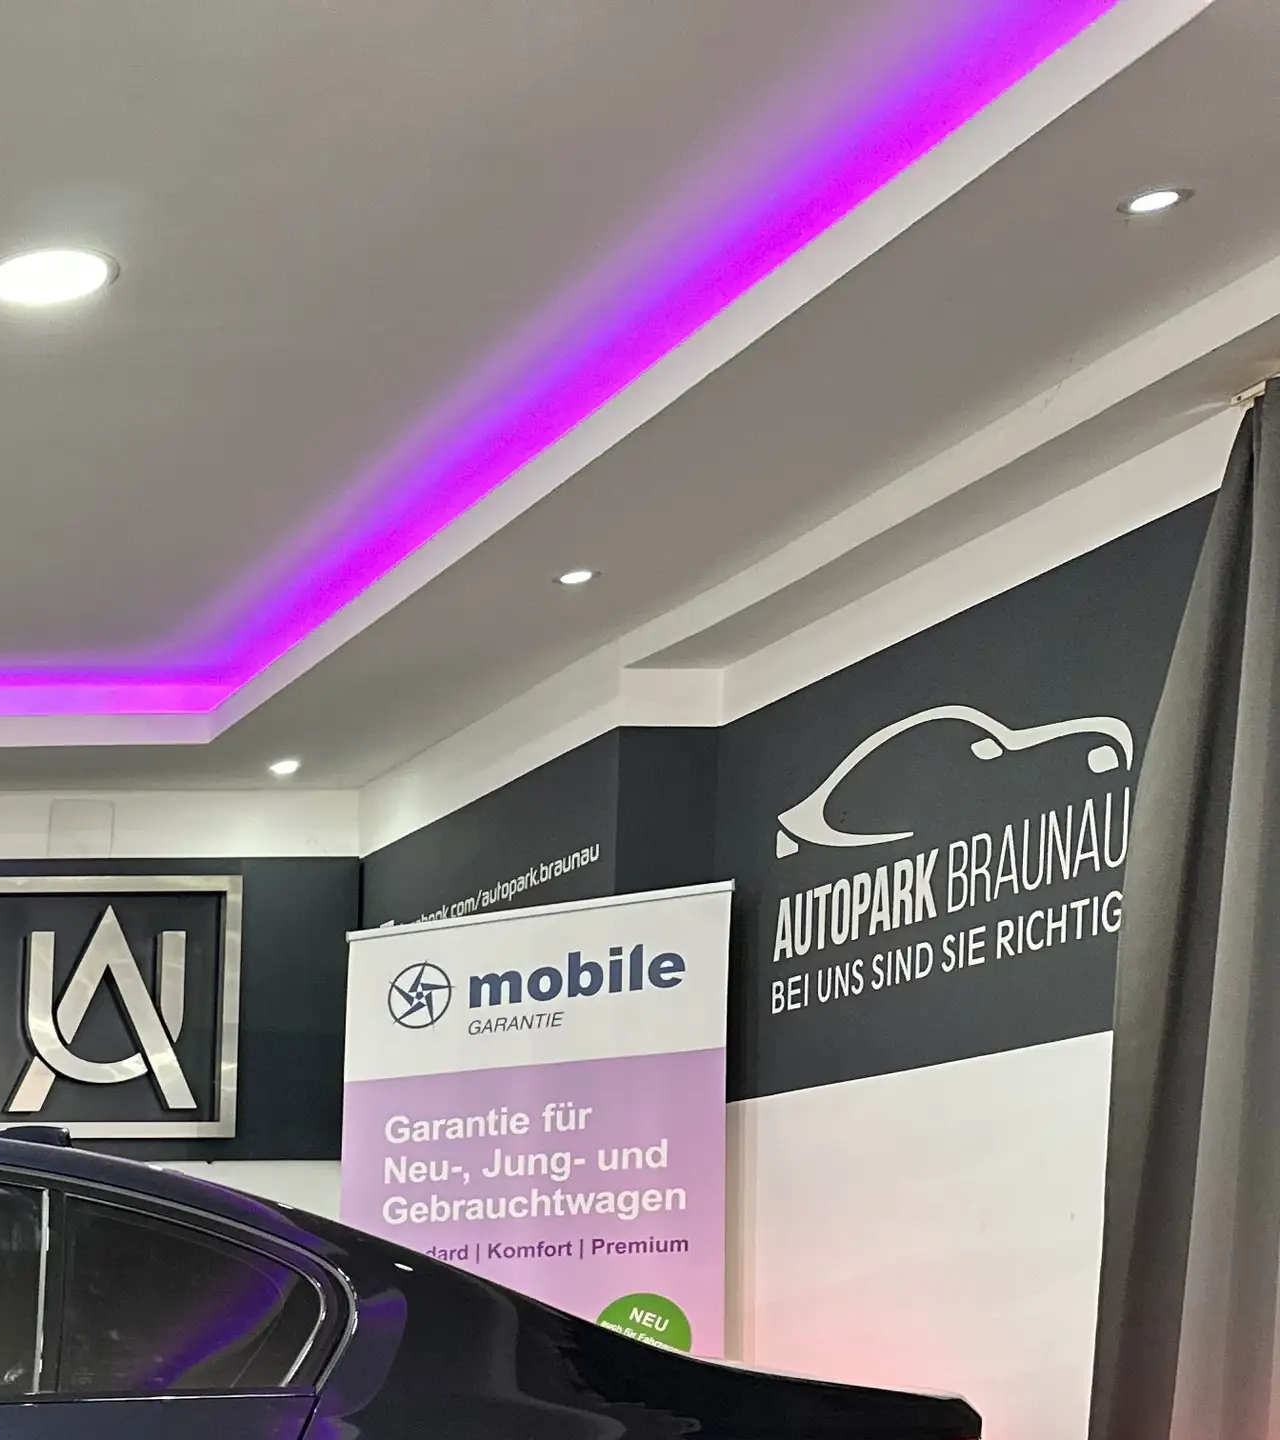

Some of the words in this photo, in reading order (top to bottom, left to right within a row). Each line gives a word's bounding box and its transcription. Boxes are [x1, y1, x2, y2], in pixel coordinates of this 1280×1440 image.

[773, 847, 941, 963] AUTOPARK
[947, 787, 1131, 914] BRAUNAU
[771, 972, 809, 1015] BEI
[817, 958, 865, 1004] UNS
[870, 940, 935, 991] SIND
[941, 925, 987, 974] SIE
[996, 890, 1124, 960] RICHTIG
[468, 943, 687, 1009] mobile
[467, 1011, 565, 1036] GARANTIE
[384, 1105, 531, 1144] Garantie
[541, 1101, 593, 1133] für
[383, 1155, 471, 1186] Neu-,
[481, 1148, 587, 1183] Jung-
[596, 1137, 669, 1172] und
[381, 1186, 688, 1226] Gebrauchtwagen
[487, 1239, 573, 1260] Komfort
[590, 1236, 690, 1256] Premium
[628, 1306, 670, 1333] NEU
